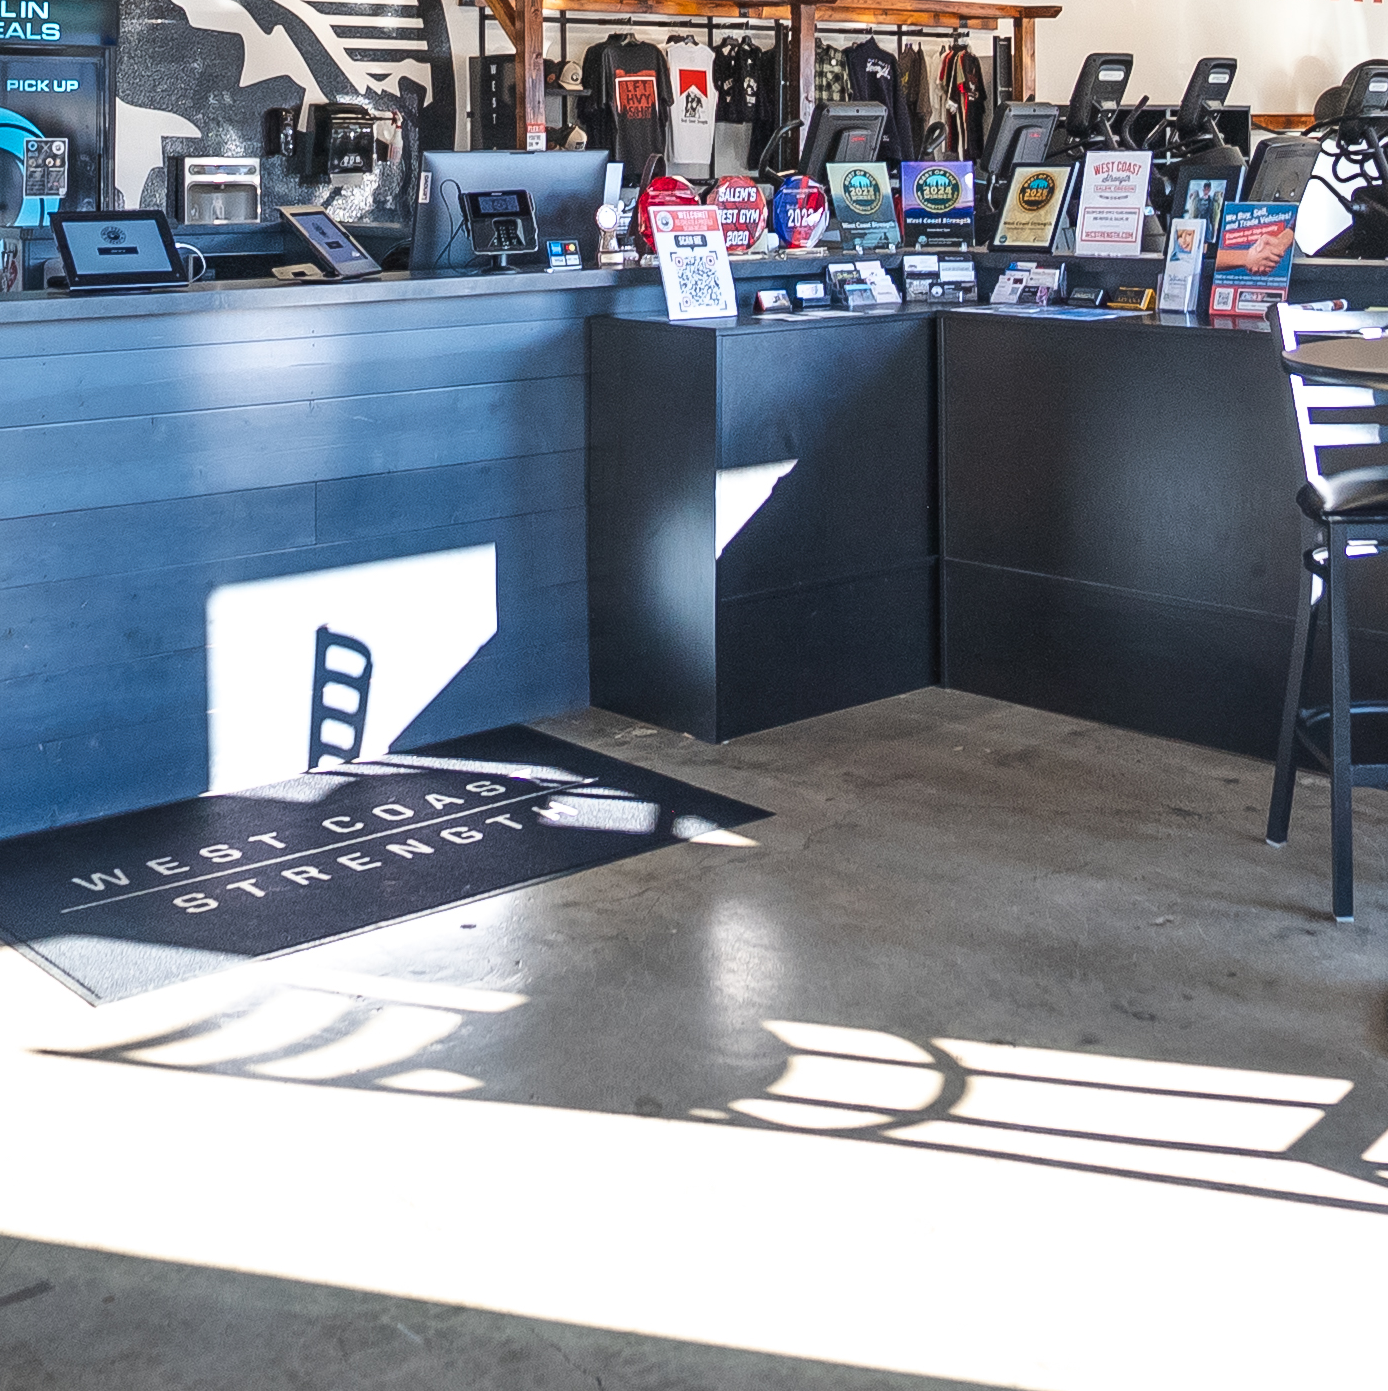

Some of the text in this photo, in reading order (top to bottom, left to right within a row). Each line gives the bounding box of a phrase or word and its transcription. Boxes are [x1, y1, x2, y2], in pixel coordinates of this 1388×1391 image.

[20, 1, 49, 20] IN
[6, 79, 79, 92] PICK UP
[626, 81, 648, 92] LFT
[627, 94, 651, 105] HVY
[1093, 161, 1142, 176] WEST COAST
[1101, 174, 1131, 185] Strength
[718, 187, 757, 202] SALEM'S
[923, 186, 952, 195] 2024
[739, 209, 759, 224] GYM
[942, 217, 971, 225] Strength
[1226, 213, 1236, 222] We
[1240, 218, 1258, 227] Trade
[1260, 211, 1292, 223] Vehicles!
[678, 235, 703, 245] SCAN ME
[726, 230, 748, 246] 2020
[71, 830, 290, 894] WEST
[172, 800, 579, 915] STRENGTH
